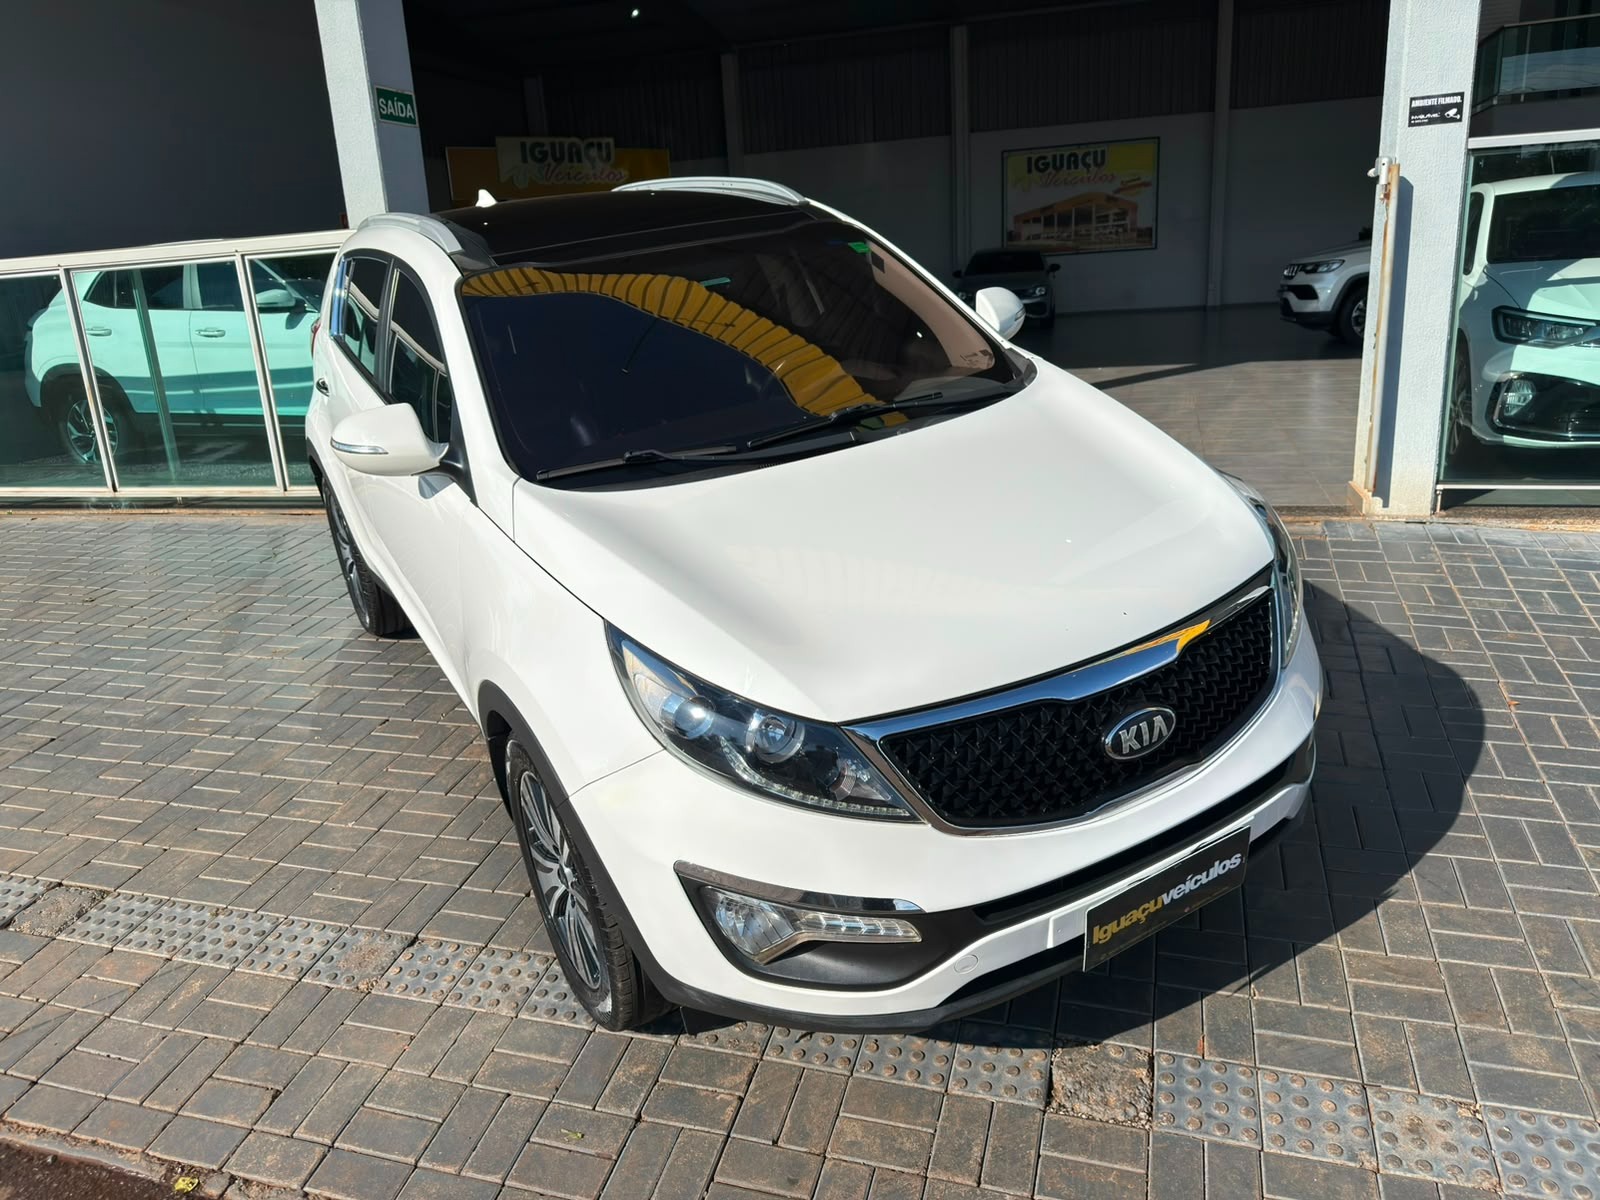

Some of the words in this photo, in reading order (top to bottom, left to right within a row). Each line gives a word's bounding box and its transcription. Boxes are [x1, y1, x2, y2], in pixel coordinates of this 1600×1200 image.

[379, 97, 414, 119] SAÍDA
[1411, 98, 1438, 107] AMBIENTE
[520, 141, 612, 169] IGUAÇU
[1026, 149, 1106, 174] IGUAÇU
[1119, 715, 1169, 754] KIA
